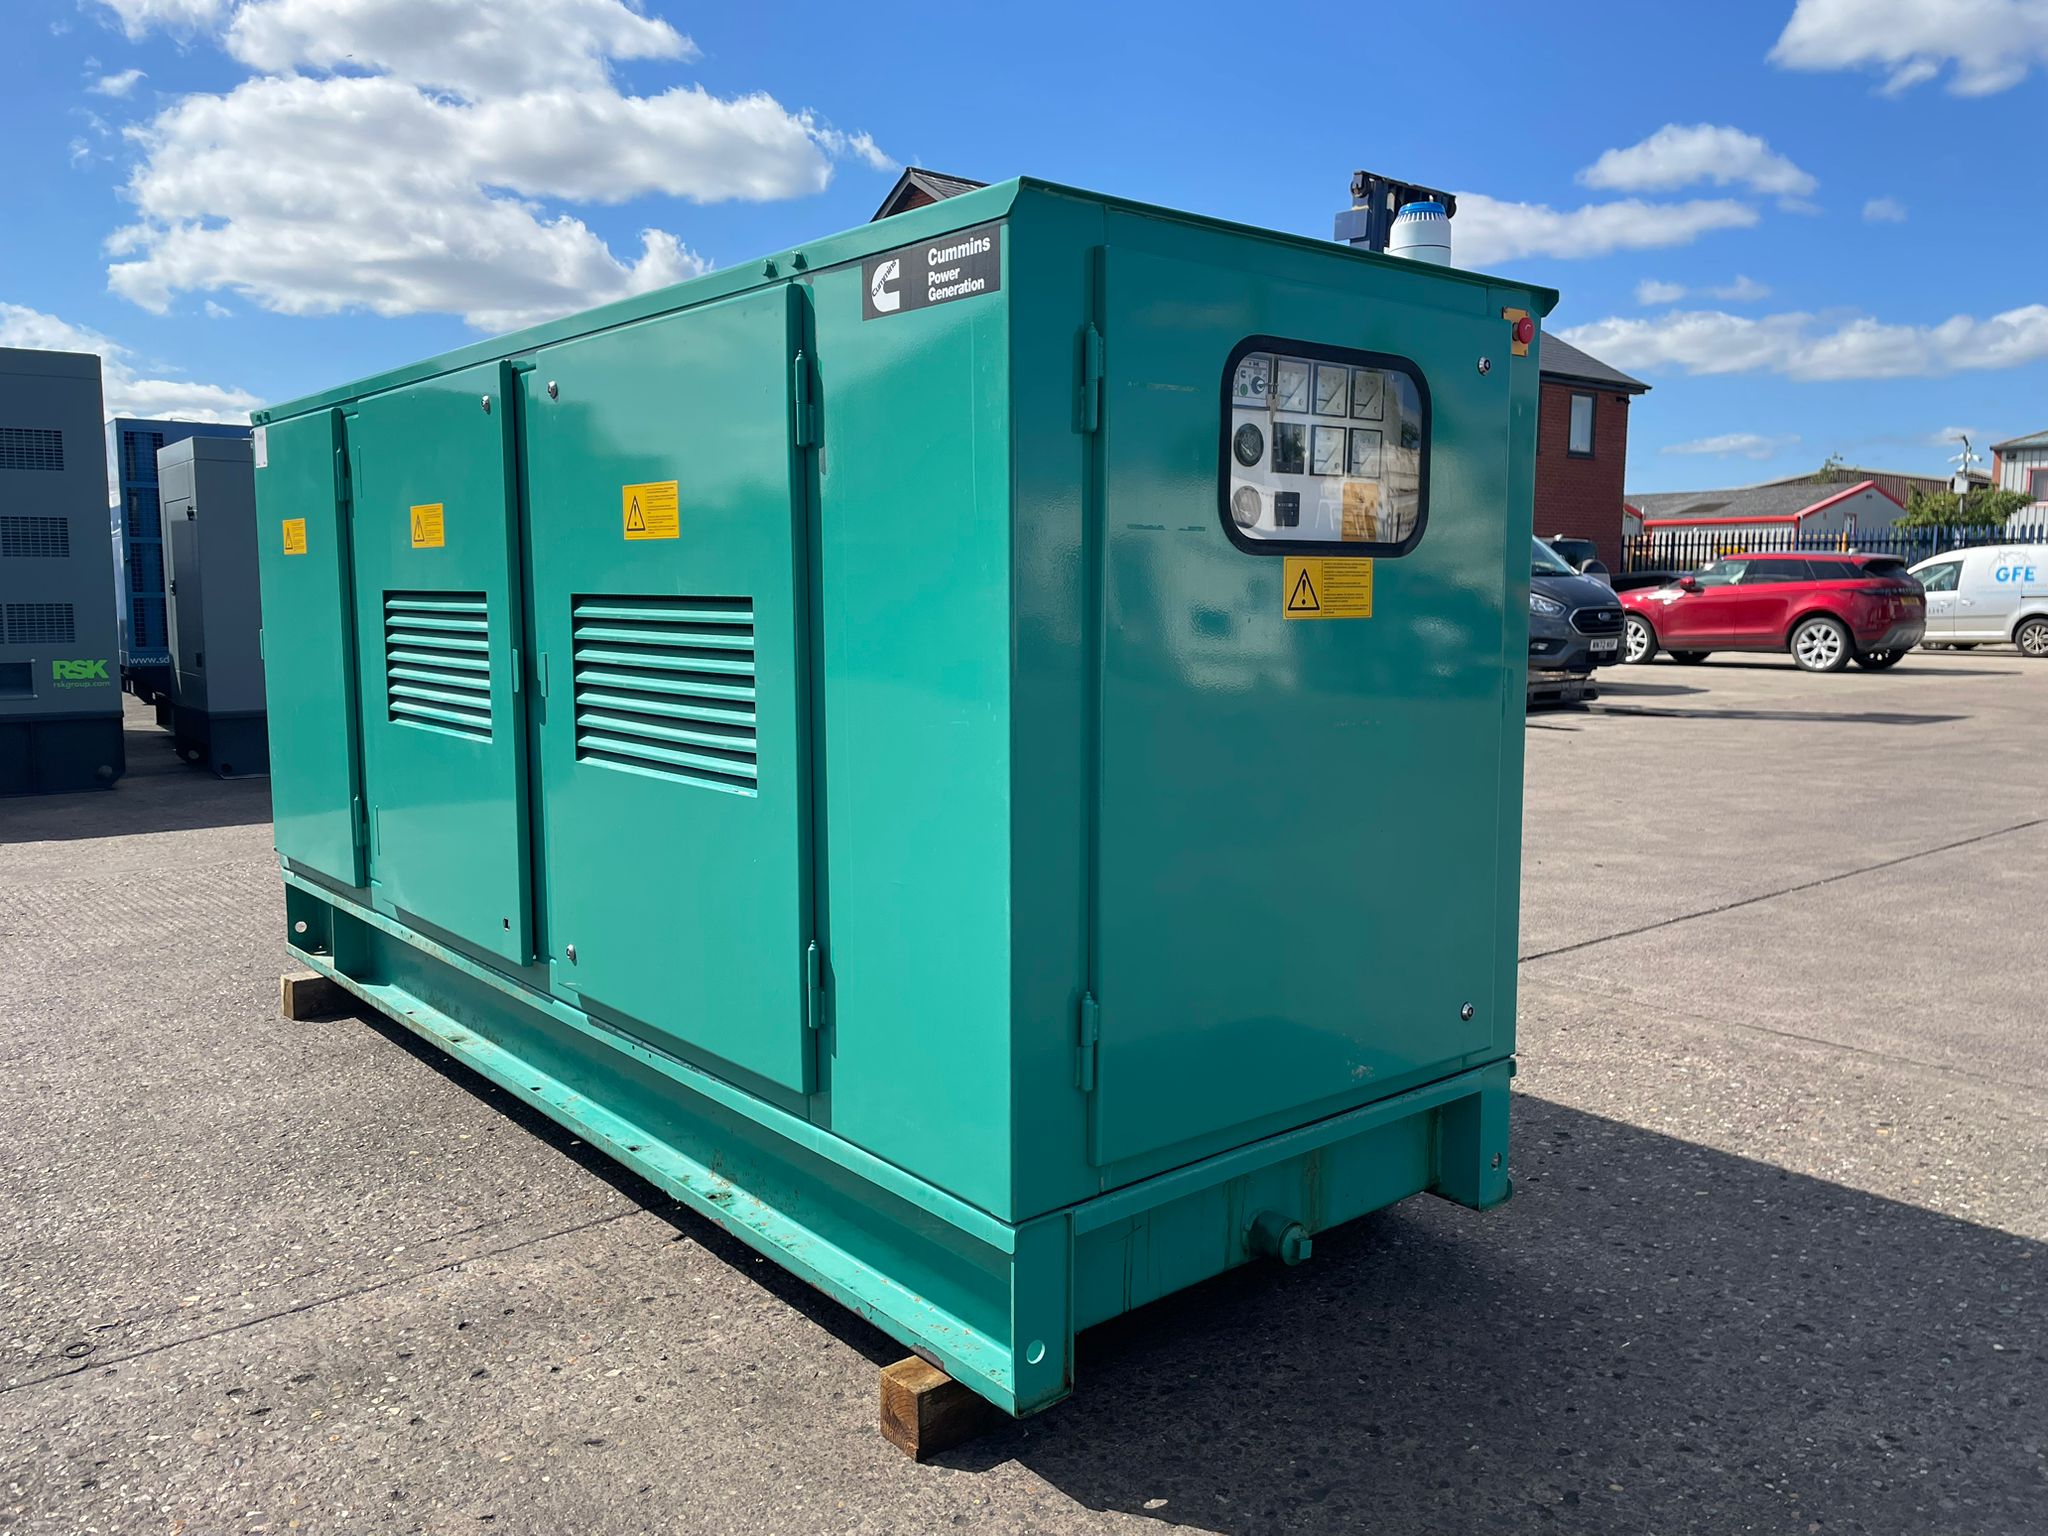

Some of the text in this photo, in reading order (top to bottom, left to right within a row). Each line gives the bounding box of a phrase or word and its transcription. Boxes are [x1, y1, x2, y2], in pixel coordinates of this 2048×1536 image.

[927, 237, 991, 266] Cummins
[871, 261, 897, 297] Cummins
[928, 267, 961, 286] Power
[928, 278, 985, 302] Generation
[1995, 566, 2036, 582] GFE
[52, 659, 109, 680] RSK
[53, 680, 111, 690] rskgroup.com
